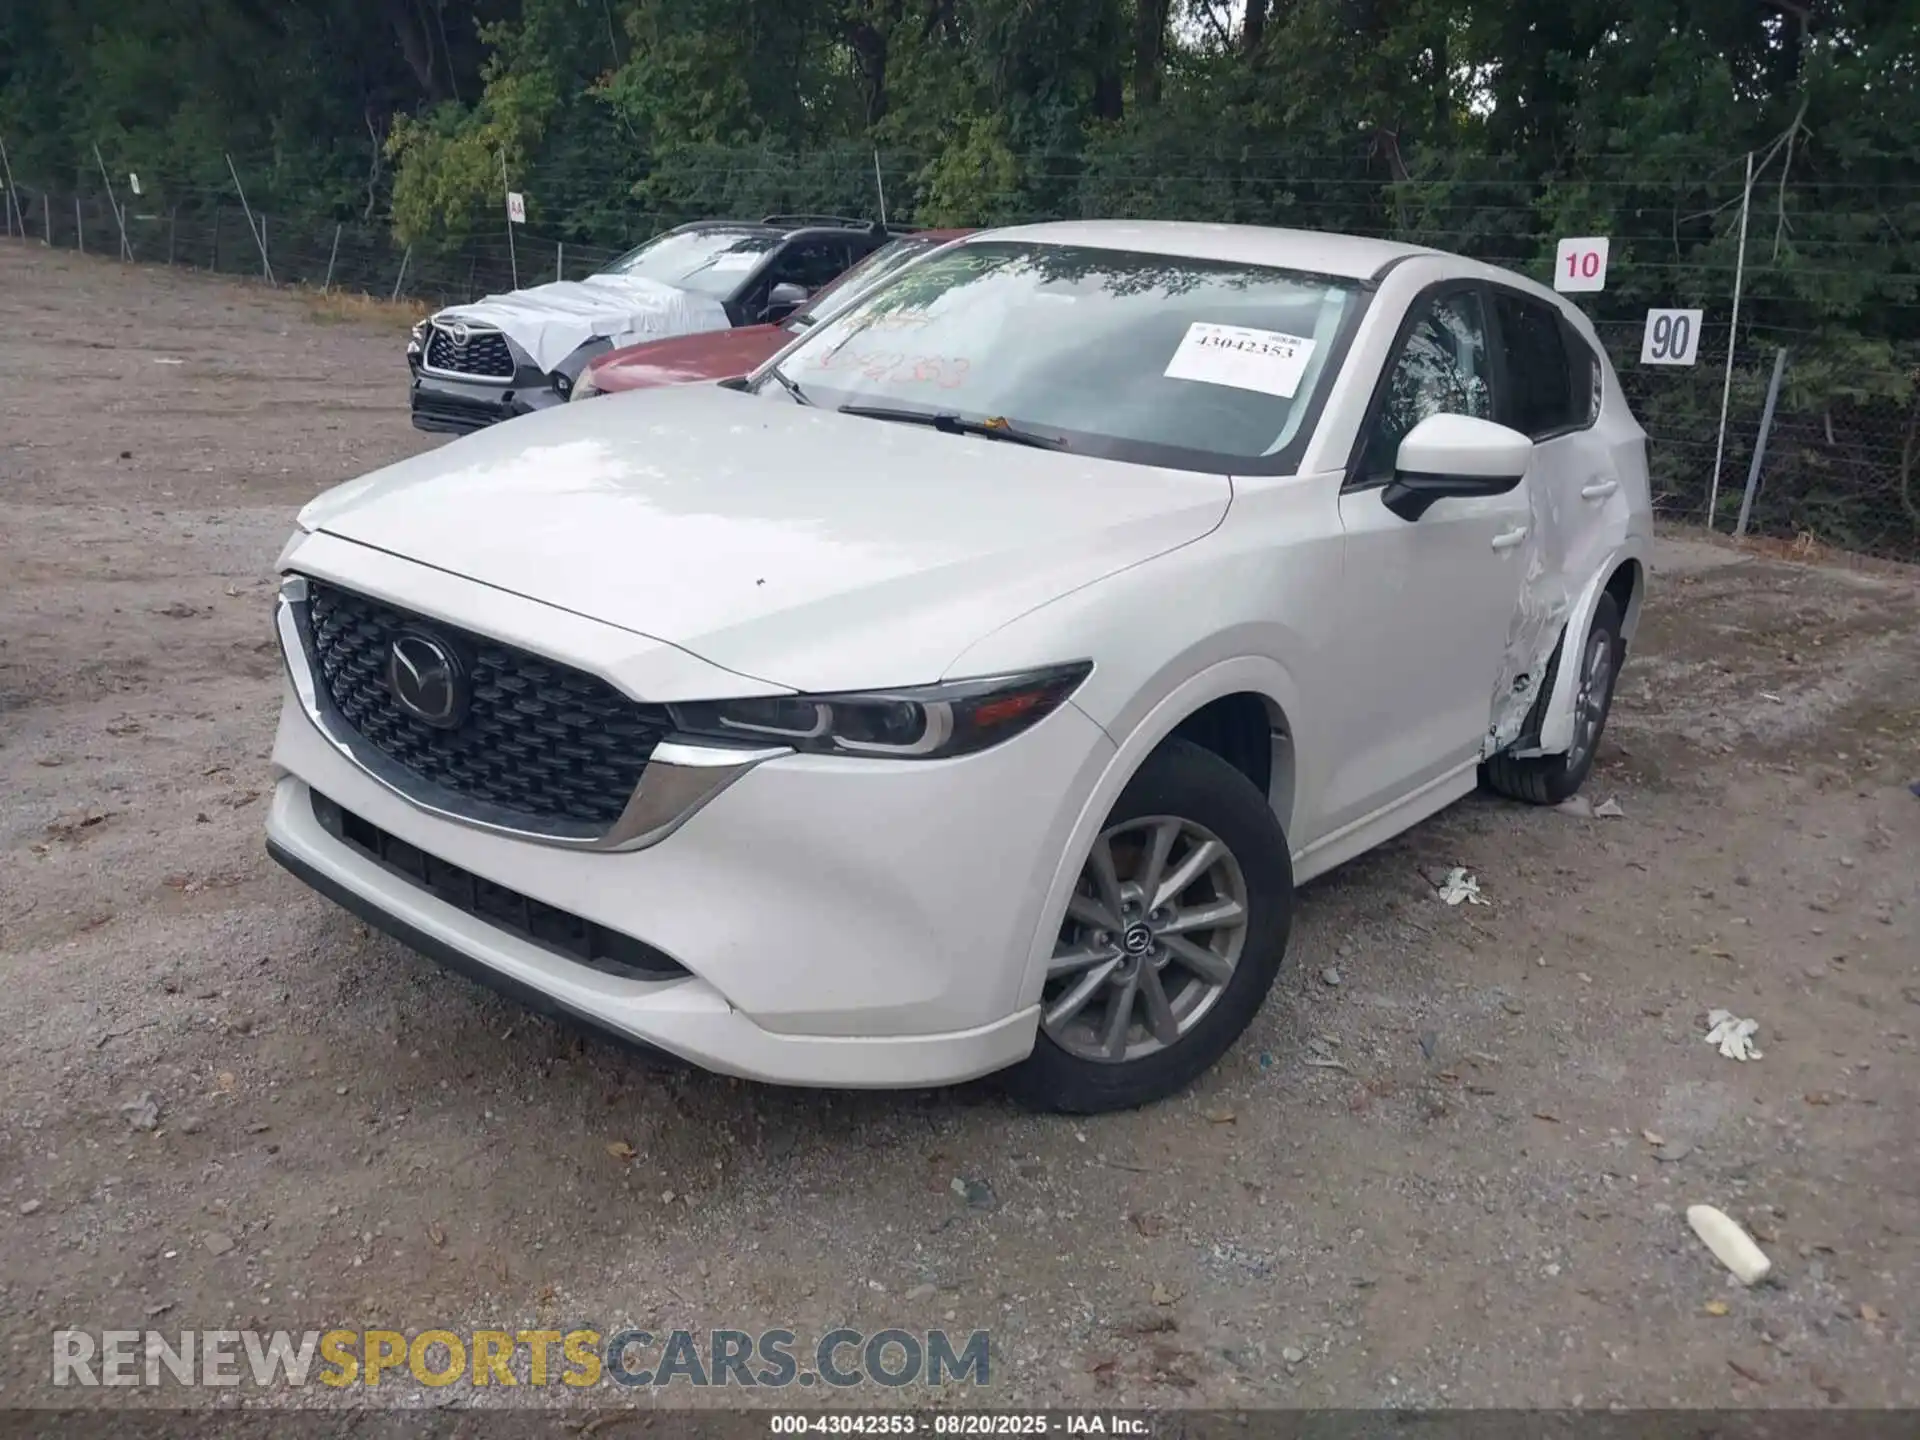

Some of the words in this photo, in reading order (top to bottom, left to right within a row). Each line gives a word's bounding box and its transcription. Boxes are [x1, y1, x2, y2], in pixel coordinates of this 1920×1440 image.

[1566, 251, 1600, 278] 10
[1195, 335, 1295, 359] 43042353
[1651, 315, 1691, 359] 90
